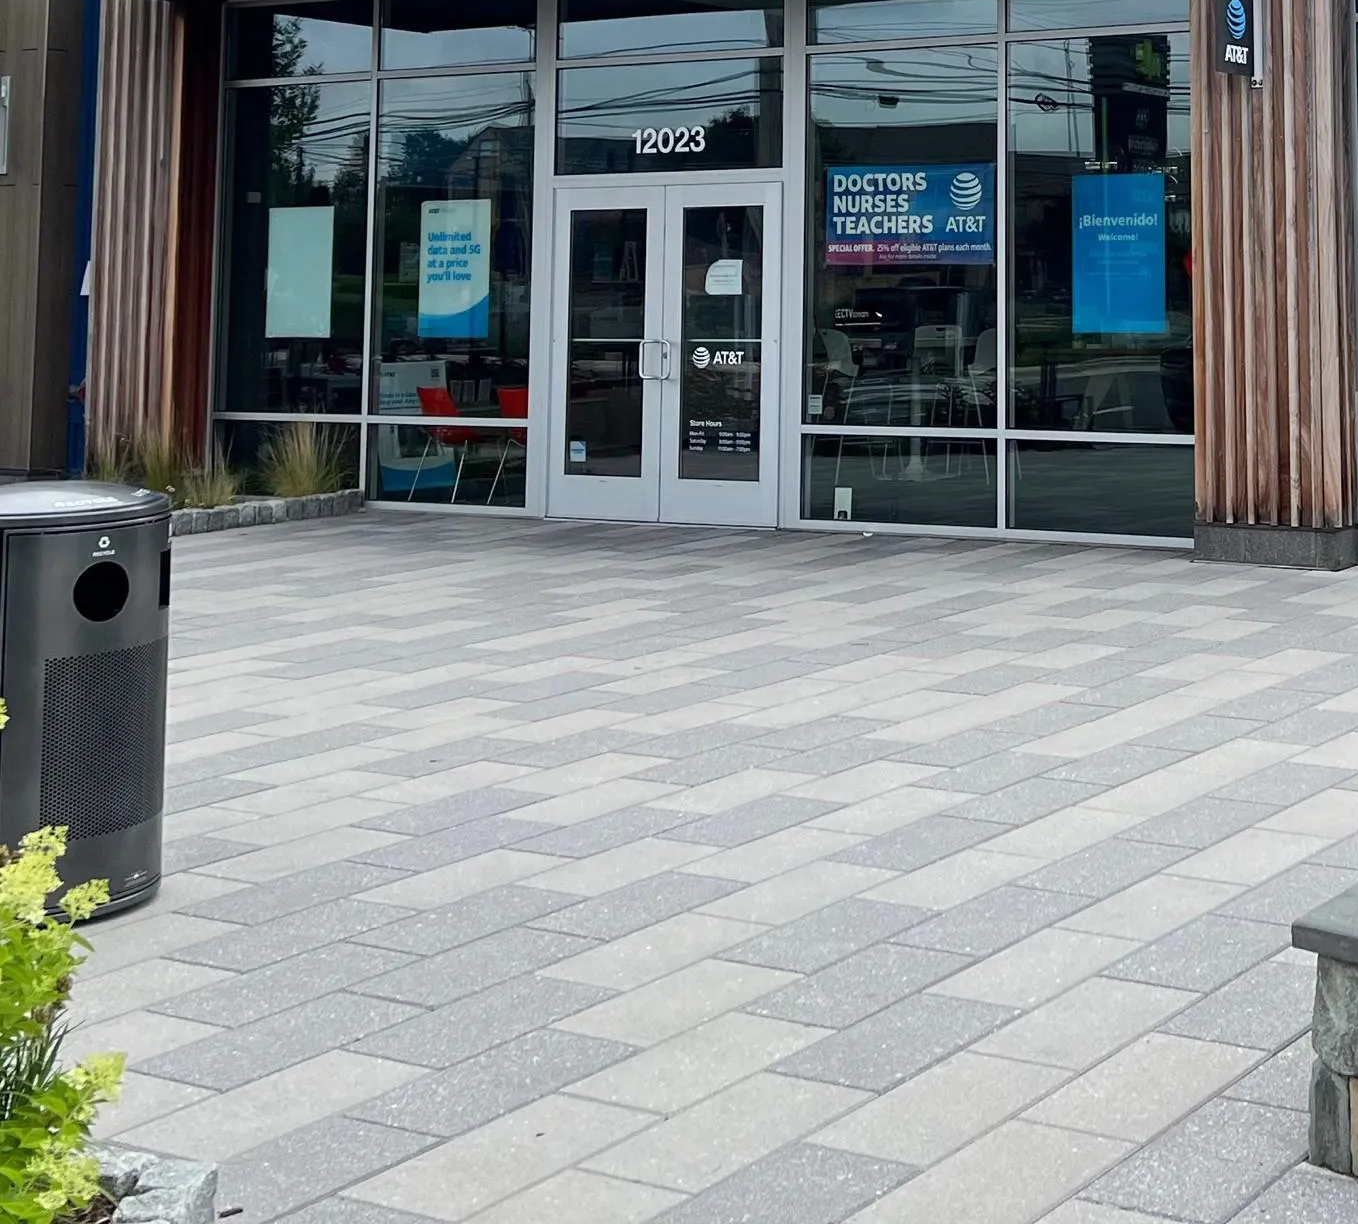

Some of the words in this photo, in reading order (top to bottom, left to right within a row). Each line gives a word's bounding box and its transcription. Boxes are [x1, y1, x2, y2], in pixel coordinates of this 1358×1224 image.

[1225, 45, 1248, 64] AT&T
[632, 126, 705, 154] 12023
[833, 172, 927, 192] DOCTORS
[833, 194, 909, 213] NURSES
[833, 215, 933, 235] TEACHERS
[945, 216, 986, 232] AT&T
[1079, 213, 1158, 229] ¡Bienvenido!
[428, 231, 472, 242] Unlimited
[1098, 233, 1138, 241] Welcome!
[428, 245, 448, 255] data
[450, 244, 467, 254] and
[470, 244, 481, 254] 5G
[828, 244, 853, 252] SPECIAL
[877, 244, 889, 252] 25%
[891, 243, 900, 251] off
[900, 243, 921, 254] eligible
[922, 243, 938, 251] AT&T
[938, 243, 954, 253] plans
[956, 243, 970, 251] each
[428, 260, 436, 268] at
[446, 257, 469, 270] price
[427, 271, 450, 284] you'll
[453, 270, 472, 280] love
[713, 351, 744, 365] AT&T
[54, 496, 119, 508] RECYCLE
